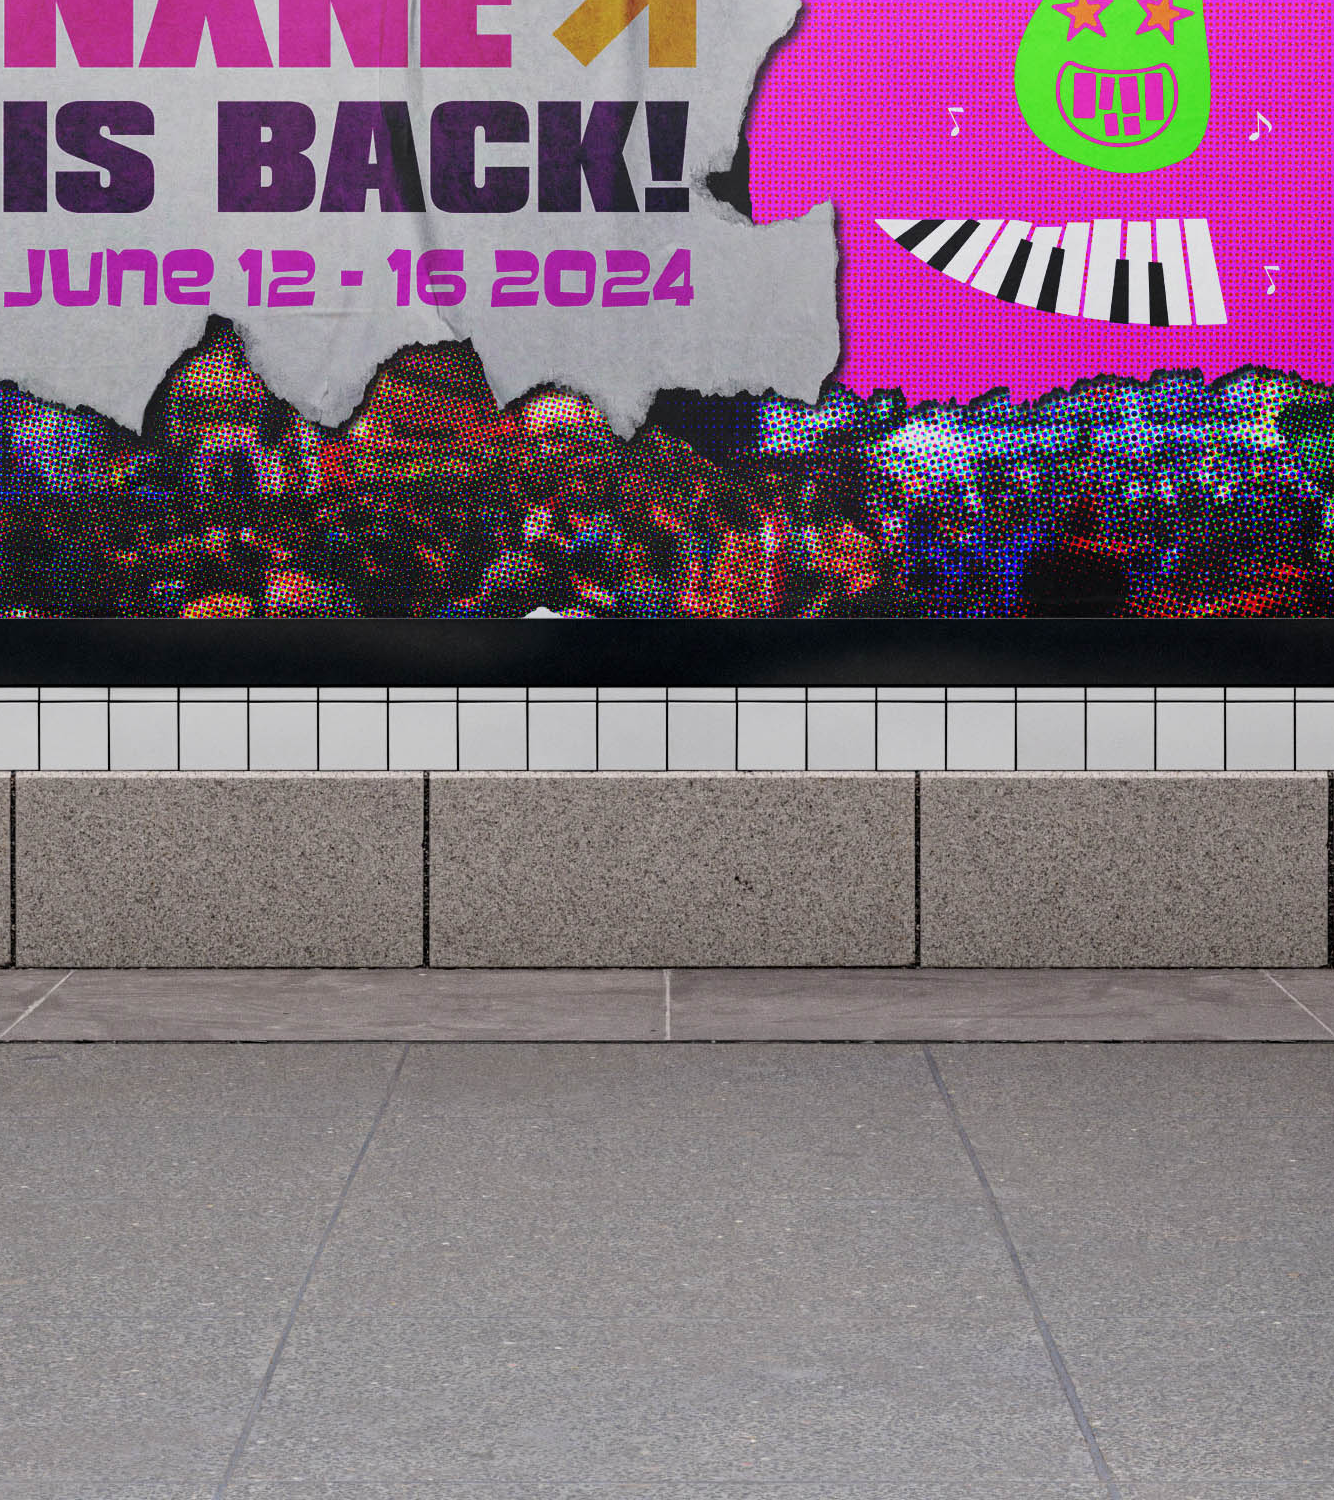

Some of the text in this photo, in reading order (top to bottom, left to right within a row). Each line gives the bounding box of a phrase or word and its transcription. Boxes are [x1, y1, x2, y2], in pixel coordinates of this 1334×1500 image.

[3, 100, 690, 214] IS BACK!
[238, 248, 317, 308] 12
[387, 248, 468, 308] 16
[490, 248, 696, 308] 2024
